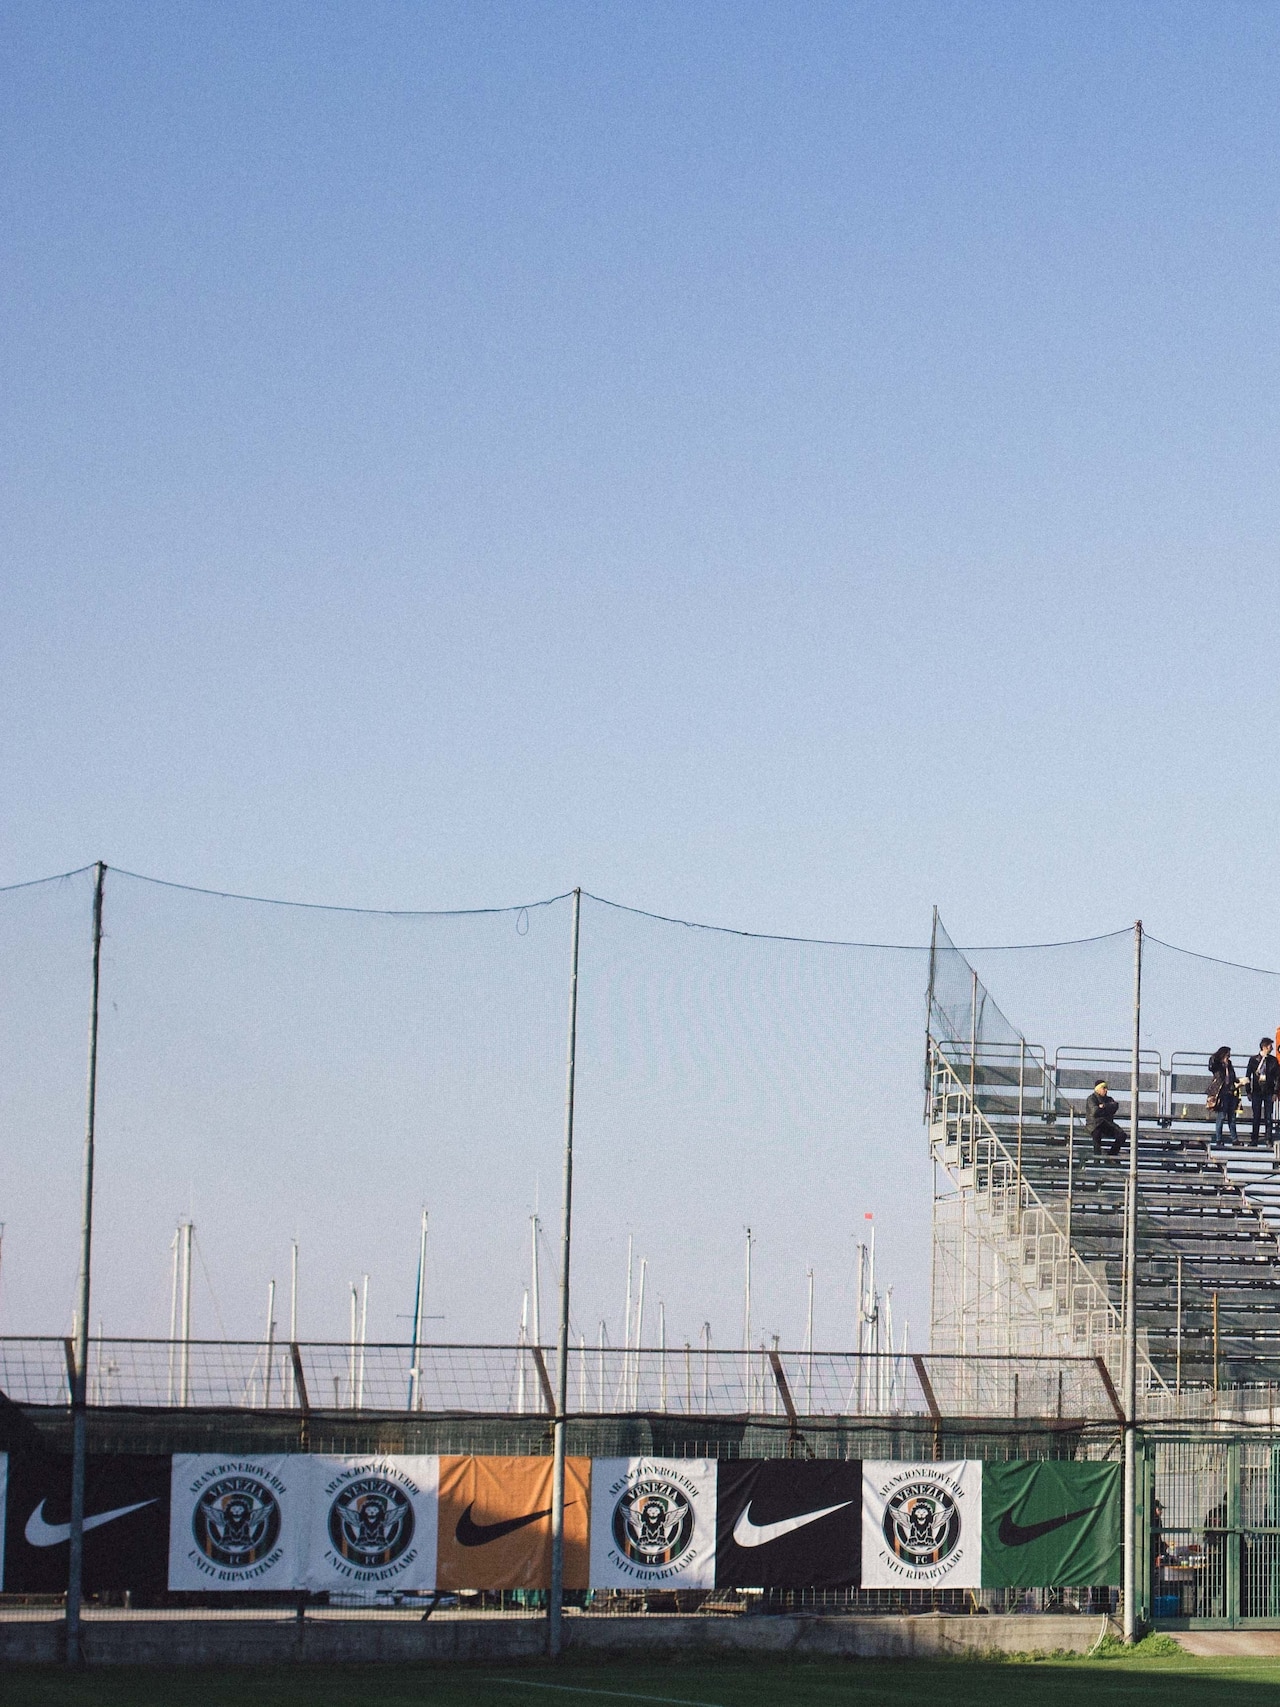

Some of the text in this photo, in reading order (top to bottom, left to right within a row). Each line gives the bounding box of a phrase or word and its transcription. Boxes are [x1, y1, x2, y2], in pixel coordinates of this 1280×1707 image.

[209, 1479, 264, 1498] VENEZIA
[344, 1479, 398, 1499] VENEZIA
[628, 1483, 679, 1501] VENEZIA
[896, 1483, 945, 1502] VENEZIA
[188, 1547, 283, 1581] UNITI RIPARTIAMO
[324, 1548, 418, 1581] UNITI RIPARTIAMO
[607, 1548, 698, 1580] UNITI RIPARTIAMO
[879, 1549, 964, 1580] UNITI RIPARTIAMO
